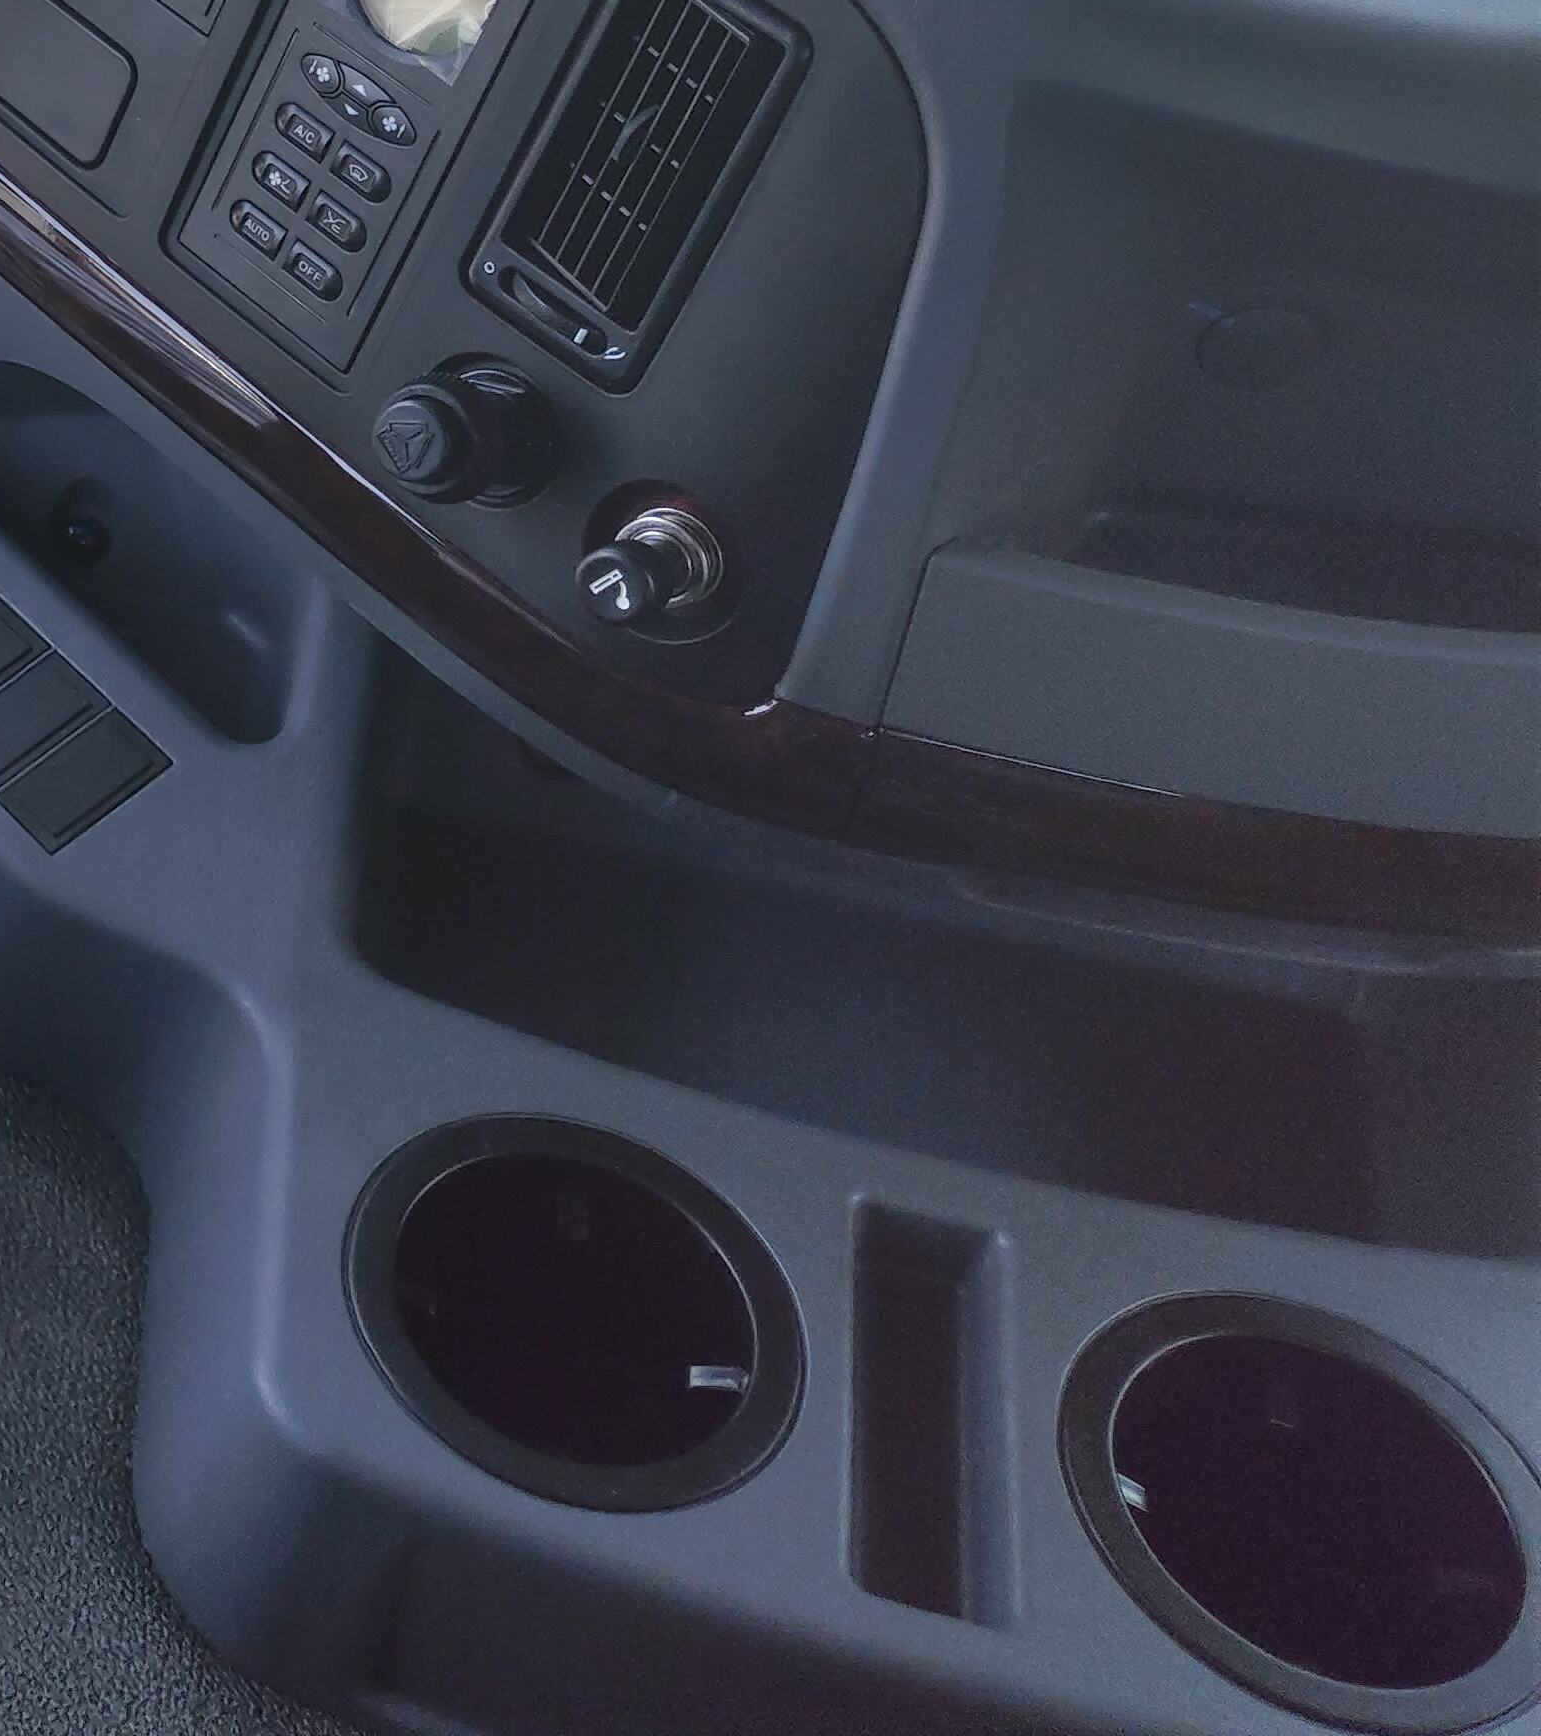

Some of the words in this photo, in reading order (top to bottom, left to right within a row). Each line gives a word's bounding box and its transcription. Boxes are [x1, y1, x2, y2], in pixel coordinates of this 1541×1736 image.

[293, 124, 316, 144] A/C
[244, 218, 271, 242] AUTO
[298, 260, 322, 282] OFF
